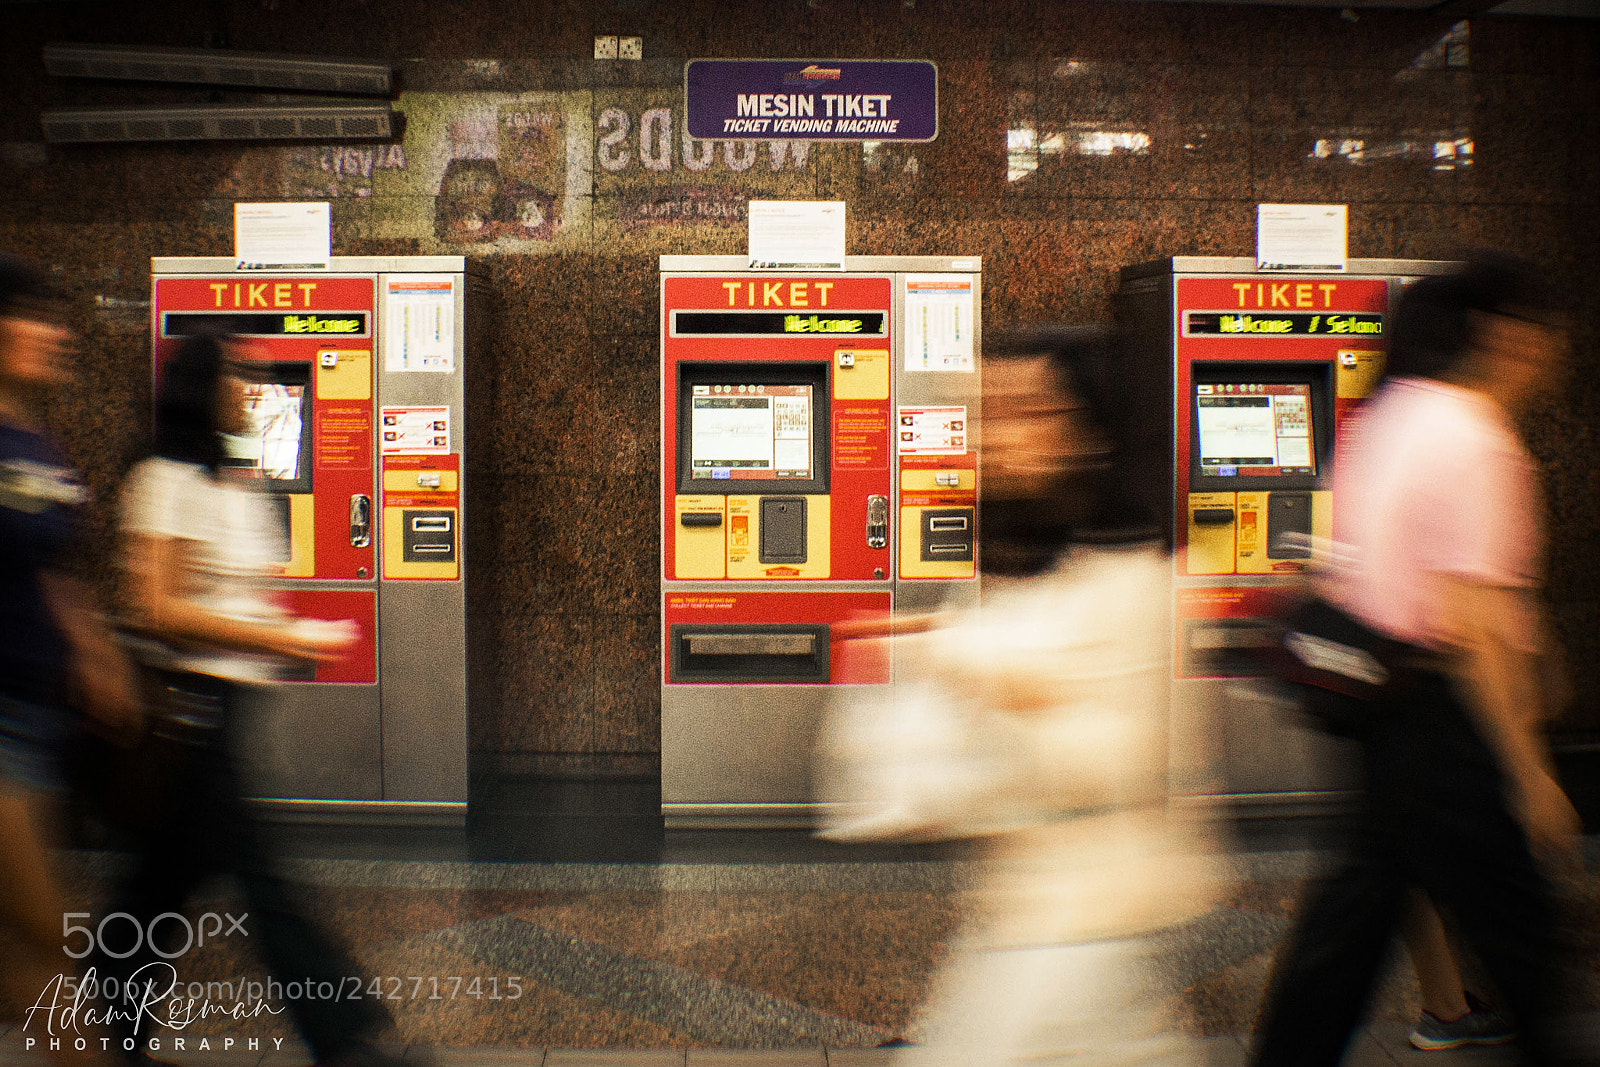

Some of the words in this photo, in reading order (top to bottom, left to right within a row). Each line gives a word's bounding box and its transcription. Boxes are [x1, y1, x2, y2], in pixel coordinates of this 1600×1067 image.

[737, 95, 814, 117] MESIN
[821, 95, 892, 117] TIKET
[722, 119, 769, 133] TICKET
[772, 119, 833, 134] VENDING
[834, 119, 900, 134] MACHINE
[209, 283, 318, 307] TIKET
[722, 281, 834, 307] TIKET
[1233, 283, 1337, 308] TIKET
[284, 315, 360, 334] Welcome
[784, 315, 863, 333] Welcome
[1219, 315, 1293, 333] Welcome
